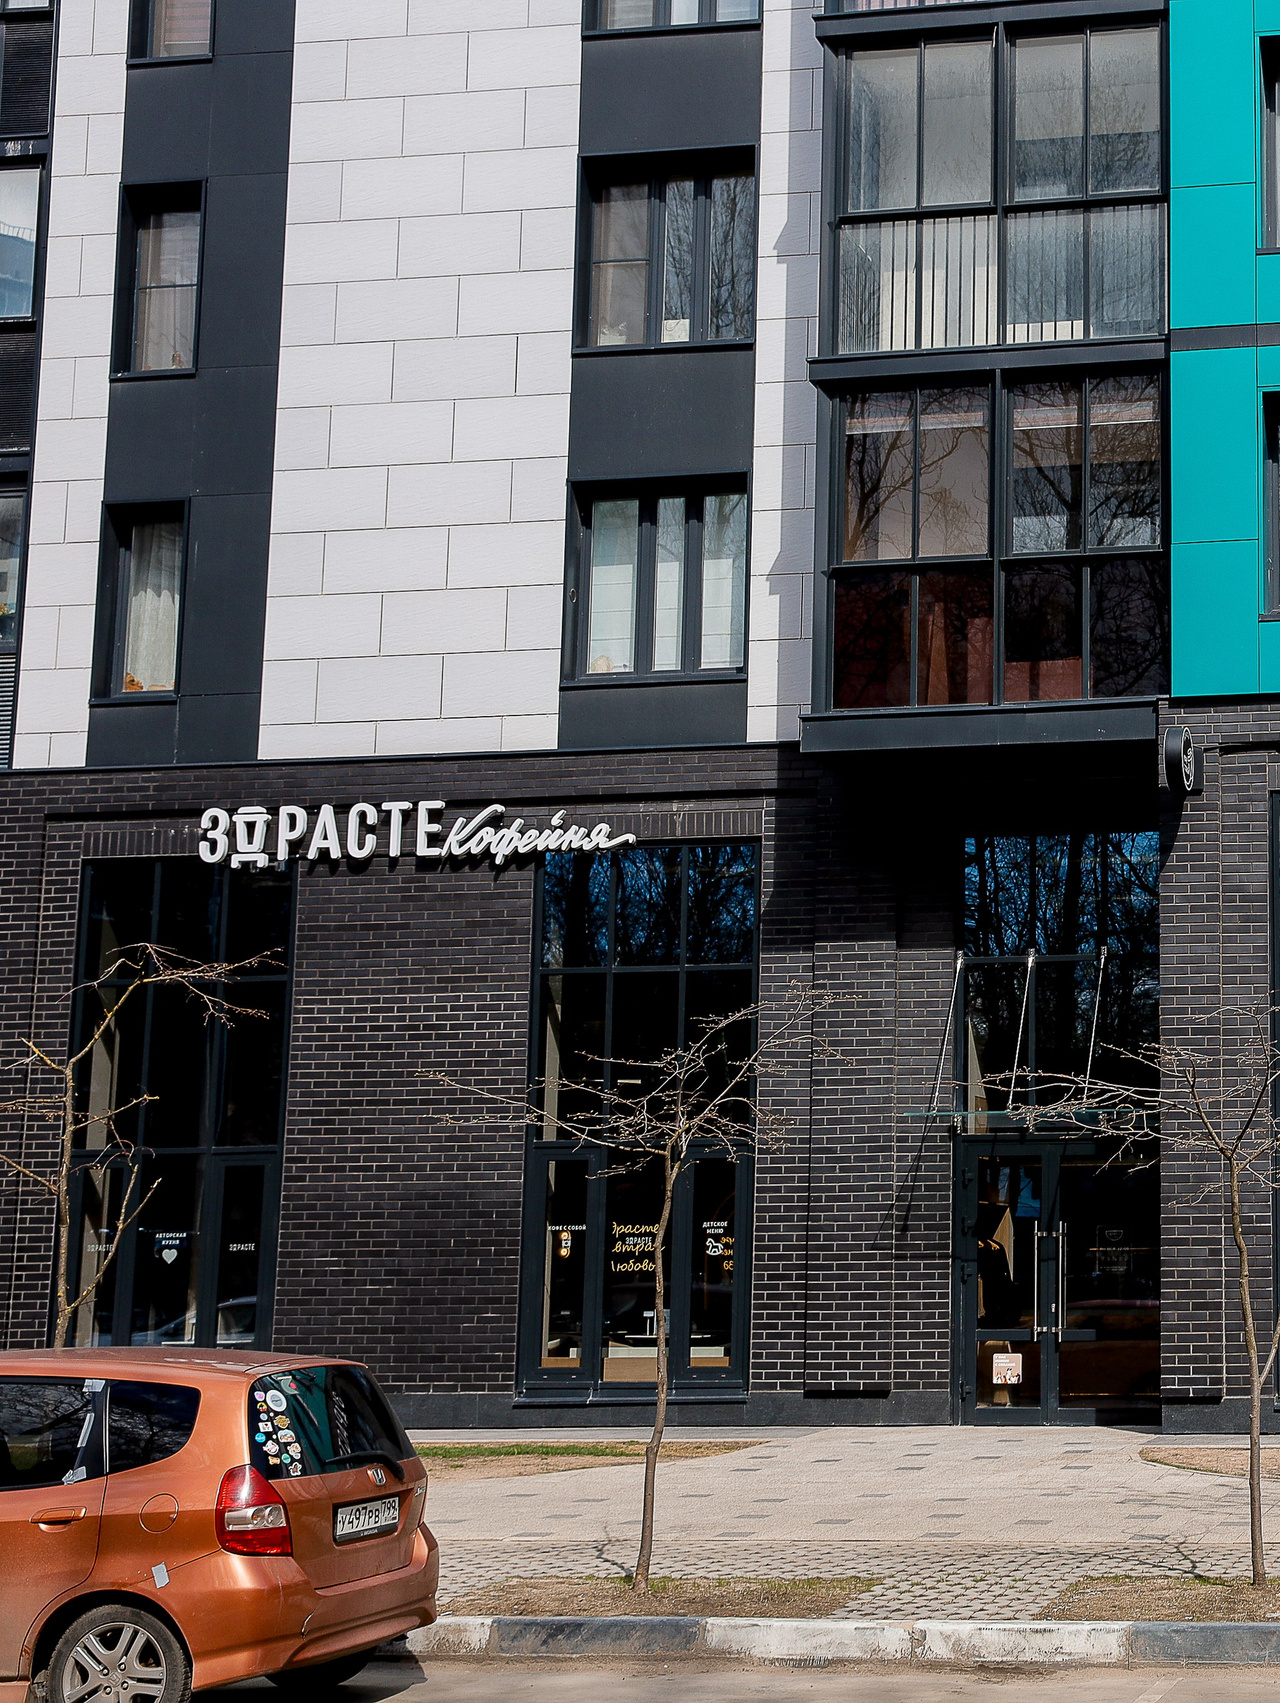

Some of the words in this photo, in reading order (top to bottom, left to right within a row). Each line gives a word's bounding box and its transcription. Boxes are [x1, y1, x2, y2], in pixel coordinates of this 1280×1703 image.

[199, 800, 446, 868] ЗДРАСТЕ
[441, 804, 637, 865] Кофейня
[625, 1236, 653, 1245] ЗДРАСТЕ
[381, 1499, 397, 1517] 799
